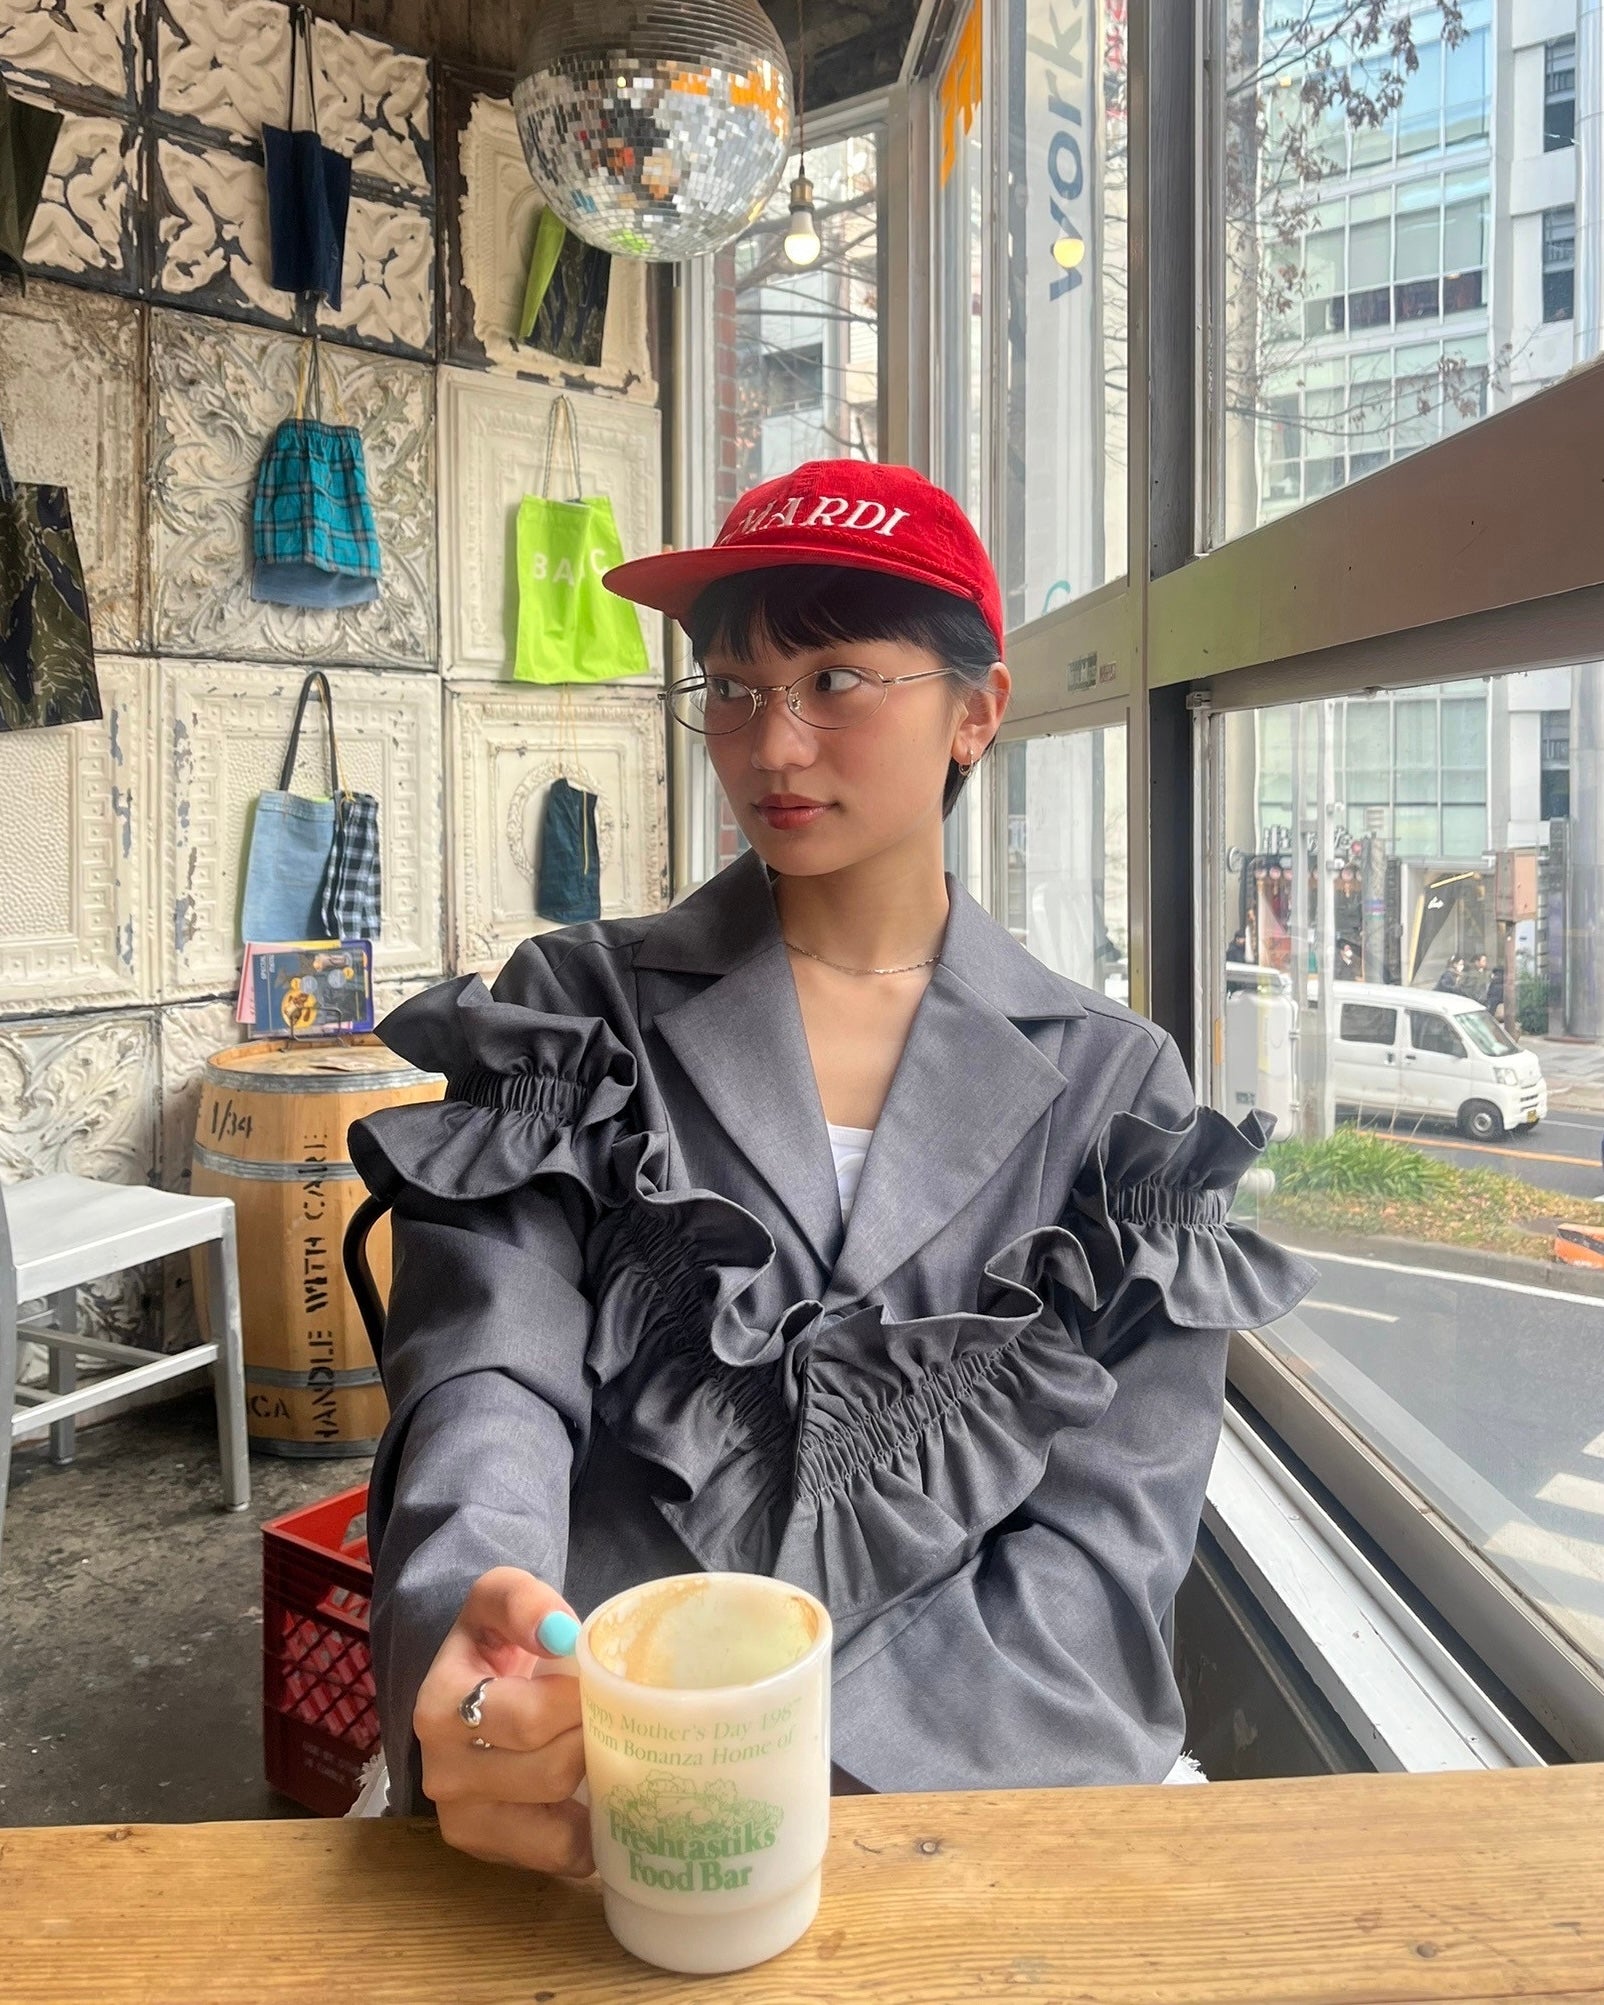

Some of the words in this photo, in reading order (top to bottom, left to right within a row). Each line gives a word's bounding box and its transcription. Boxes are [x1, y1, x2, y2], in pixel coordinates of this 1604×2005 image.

[1027, 0, 1084, 301] work
[720, 496, 911, 545] MARDI
[211, 1099, 253, 1142] 1/34
[299, 1134, 329, 1220] CARE
[303, 1237, 329, 1314] WITH
[307, 1330, 340, 1438] HANDLE
[588, 1717, 618, 1751] From
[623, 1738, 704, 1766] Bonanza
[711, 1741, 769, 1765] Home
[777, 1725, 798, 1749] of
[620, 1714, 705, 1742] Mother's
[714, 1719, 752, 1740] Day
[609, 1810, 777, 1861] Freshtastiks
[629, 1850, 695, 1891] Food
[700, 1860, 753, 1891] Bar
